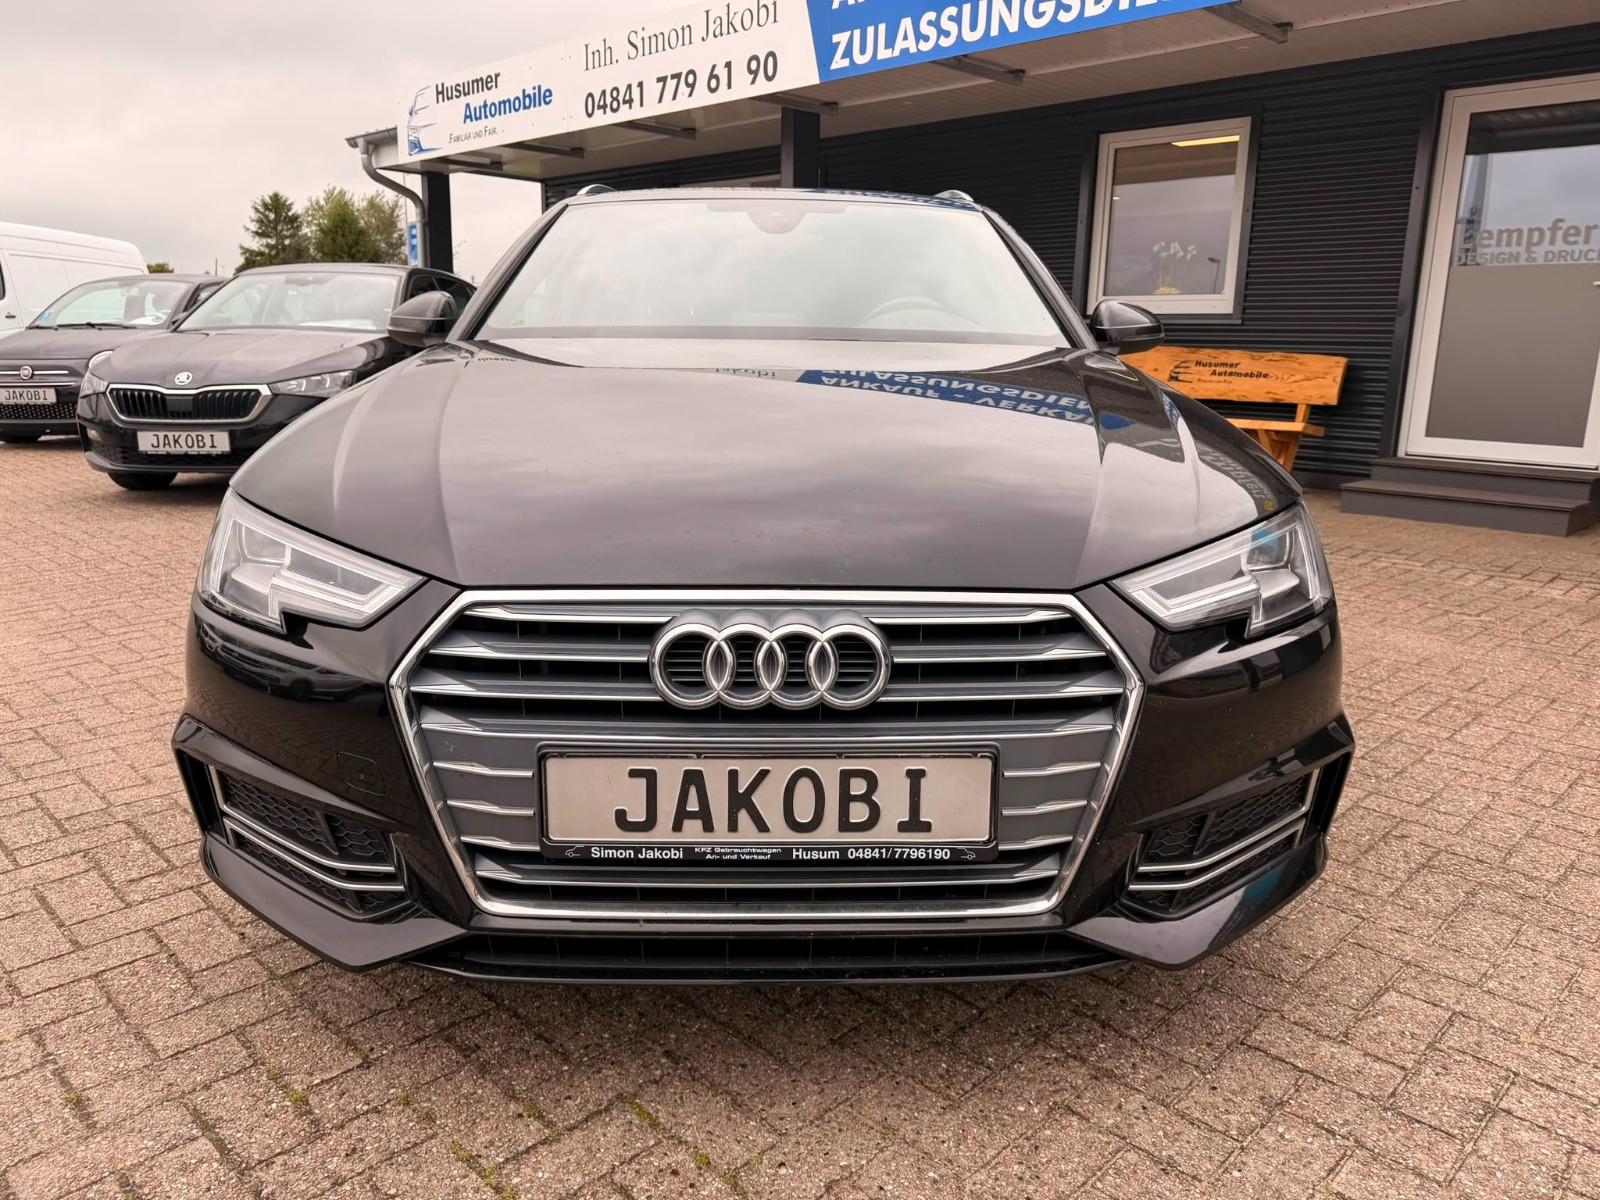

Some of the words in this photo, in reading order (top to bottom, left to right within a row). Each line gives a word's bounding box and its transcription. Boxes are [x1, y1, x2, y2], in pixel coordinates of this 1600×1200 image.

[584, 38, 619, 72] Inh.
[627, 23, 693, 61] Simon
[701, 0, 779, 42] Jakobi
[435, 72, 500, 104] Husumer
[585, 80, 644, 118] 04841
[656, 68, 697, 104] 779
[706, 60, 732, 94] 61
[746, 50, 778, 85] 90
[463, 84, 553, 124] Automobile
[1456, 250, 1521, 265] DESIGN
[1525, 250, 1537, 263] &
[1195, 360, 1241, 369] Husumer
[1210, 369, 1269, 379] Automobile
[5, 390, 48, 401] JAKOBI
[151, 433, 217, 449] JAKOBI
[614, 768, 933, 833] JAKOBI
[591, 847, 634, 859] Simon
[638, 848, 683, 860] Jakobi
[792, 848, 840, 860] Husum
[847, 847, 951, 860] 04841/7796190
